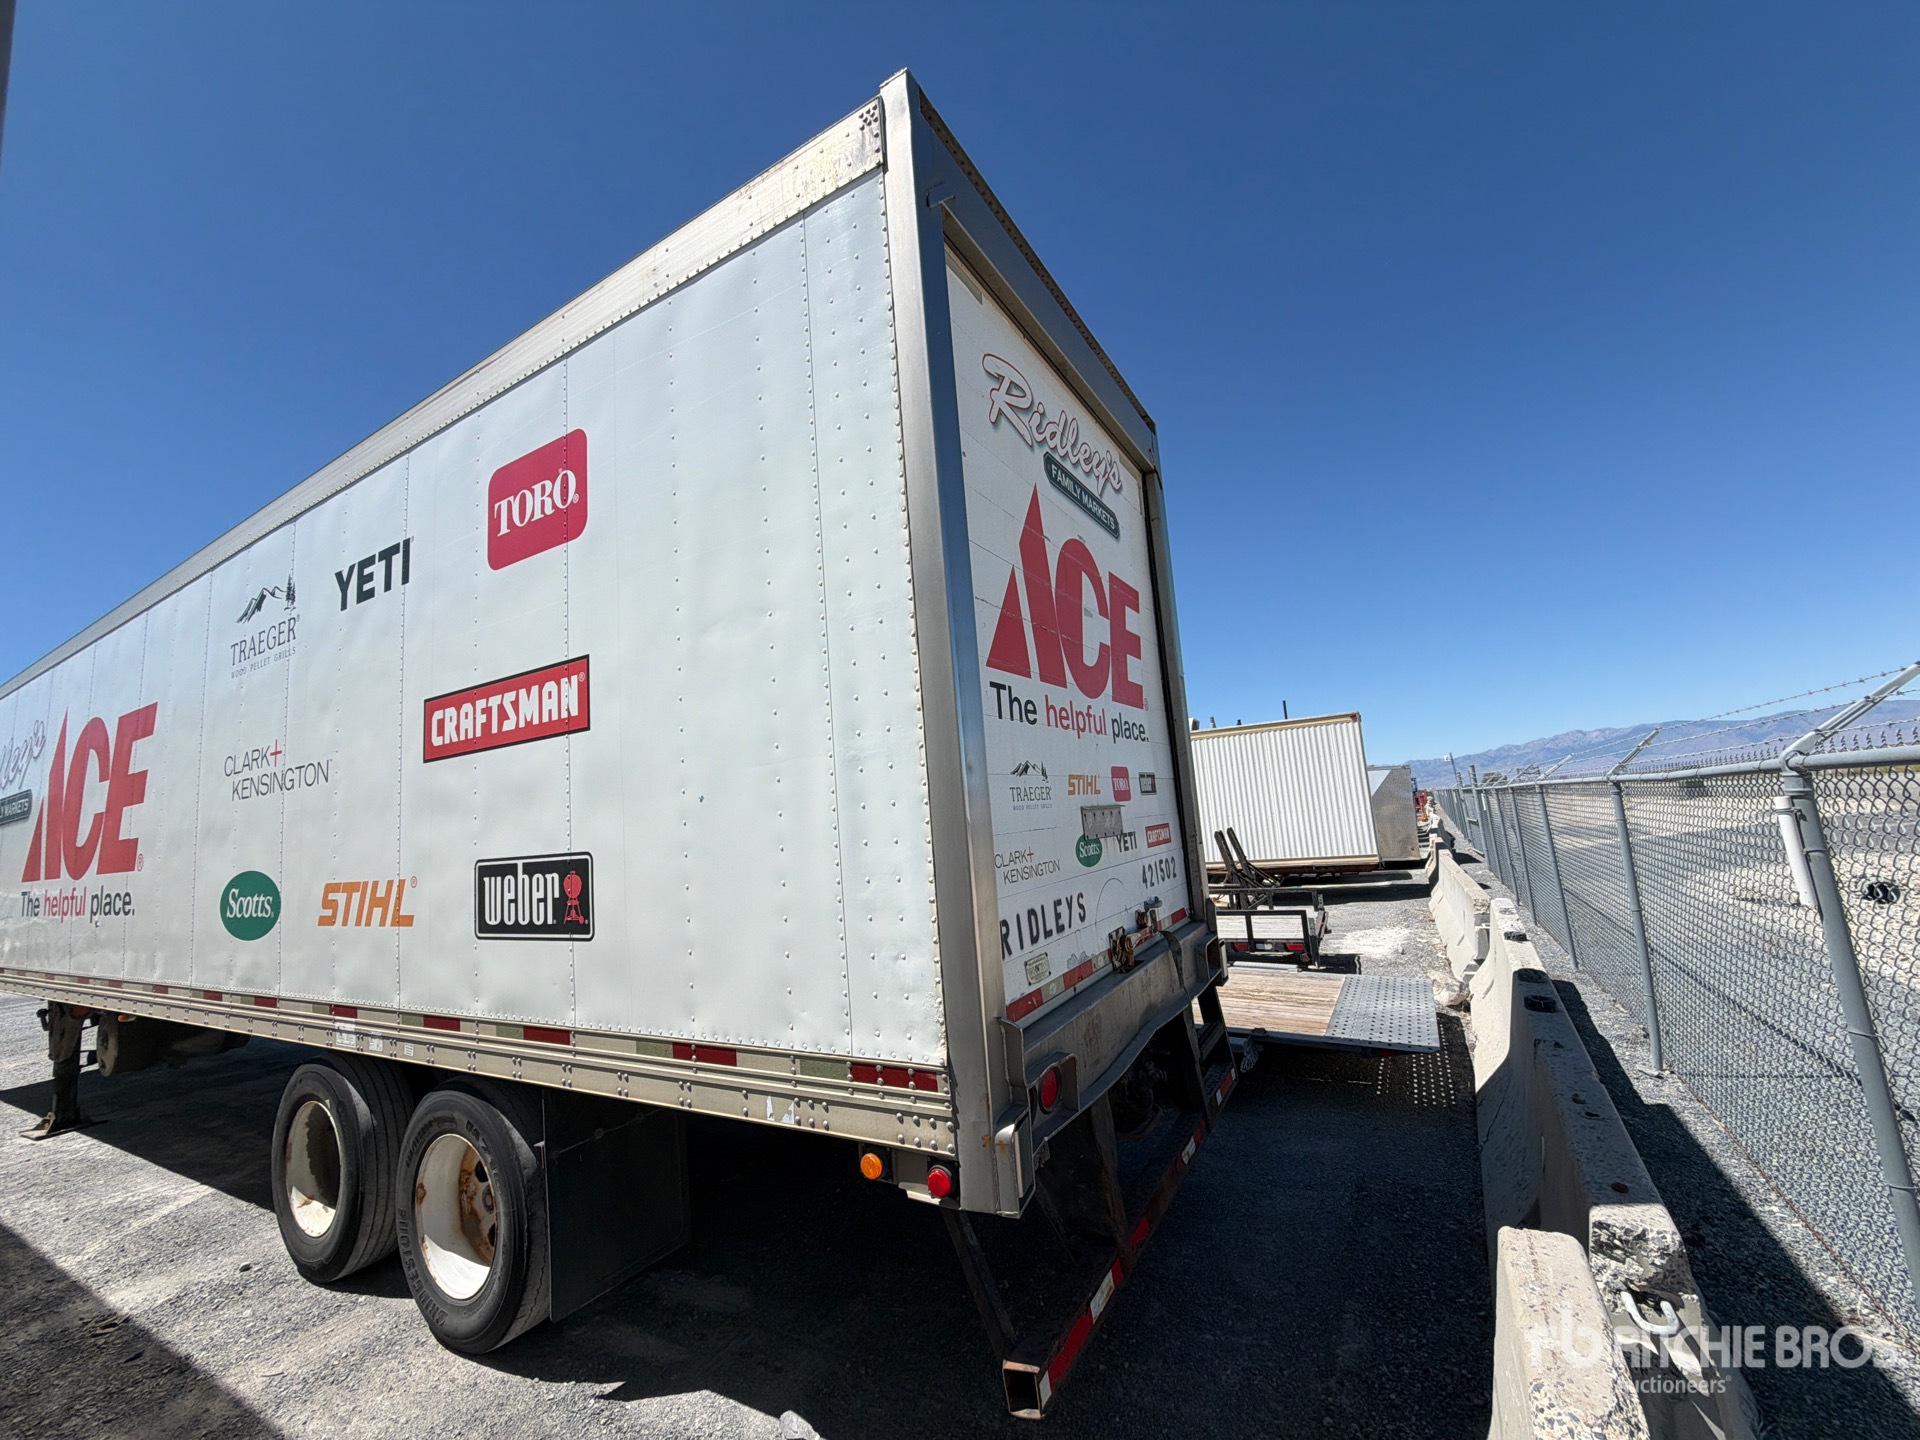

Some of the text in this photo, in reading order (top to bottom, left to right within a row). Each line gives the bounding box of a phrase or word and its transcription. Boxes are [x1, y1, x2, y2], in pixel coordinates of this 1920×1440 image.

[982, 353, 1122, 498] Ridley's
[494, 468, 577, 537] TORO
[1051, 463, 1115, 530] FAMILY MARKETS
[334, 537, 411, 611] YETI
[985, 482, 1144, 710] ACE
[230, 616, 297, 666] TRAEGER
[274, 646, 296, 661] GRILLS
[431, 674, 579, 747] CRAFTSMAN
[989, 681, 1149, 743] The helpful place.
[21, 701, 159, 882] ACE
[231, 761, 330, 801] KENSINGTON
[1010, 786, 1052, 802] TRAEGER
[1068, 774, 1100, 795] STIHL
[1079, 840, 1100, 858] Scotts
[1115, 831, 1138, 853] YETI
[483, 862, 560, 926] weber
[1003, 859, 1061, 885] KENSINGTON
[1142, 857, 1177, 889] 421502
[20, 886, 136, 923] The helpful place.
[226, 888, 272, 919] Scotts
[317, 879, 415, 928] STIHL
[999, 892, 1087, 960] RIDLEYS
